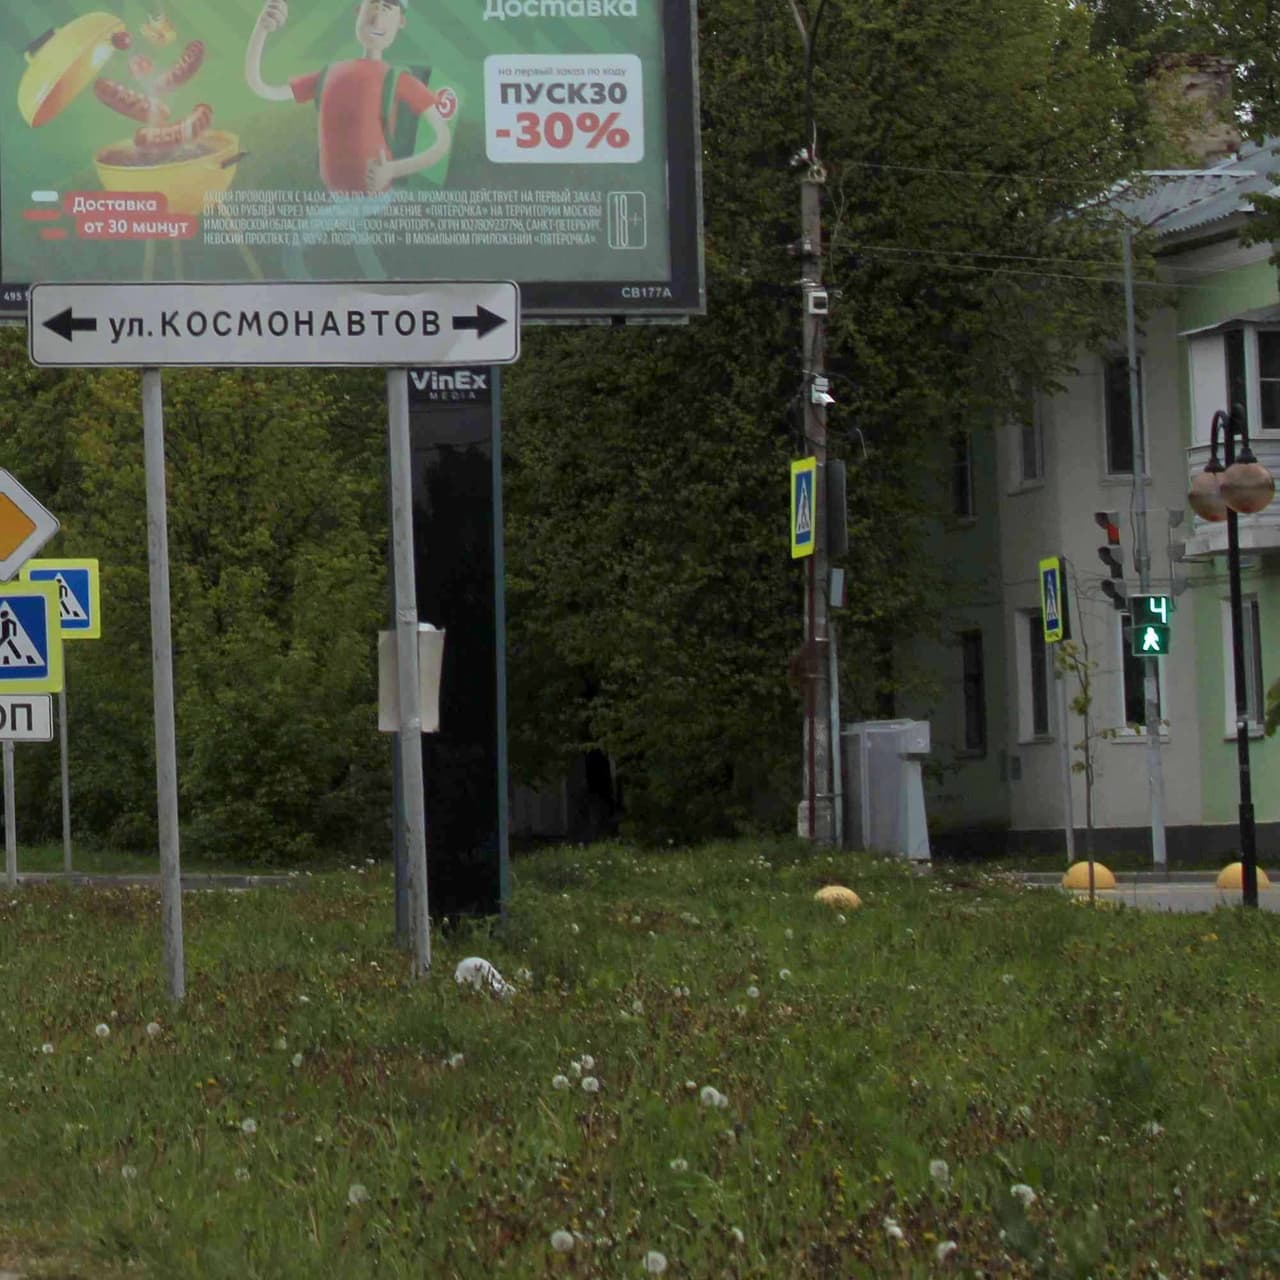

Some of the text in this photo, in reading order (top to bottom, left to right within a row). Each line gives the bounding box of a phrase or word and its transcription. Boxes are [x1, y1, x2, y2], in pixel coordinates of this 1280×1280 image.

[500, 82, 628, 104] ПУСК30
[495, 111, 630, 149] -30%
[72, 196, 157, 213] Доставка
[83, 220, 189, 237] от 30 минут
[409, 371, 488, 391] VinEx
[1150, 597, 1167, 624] 4
